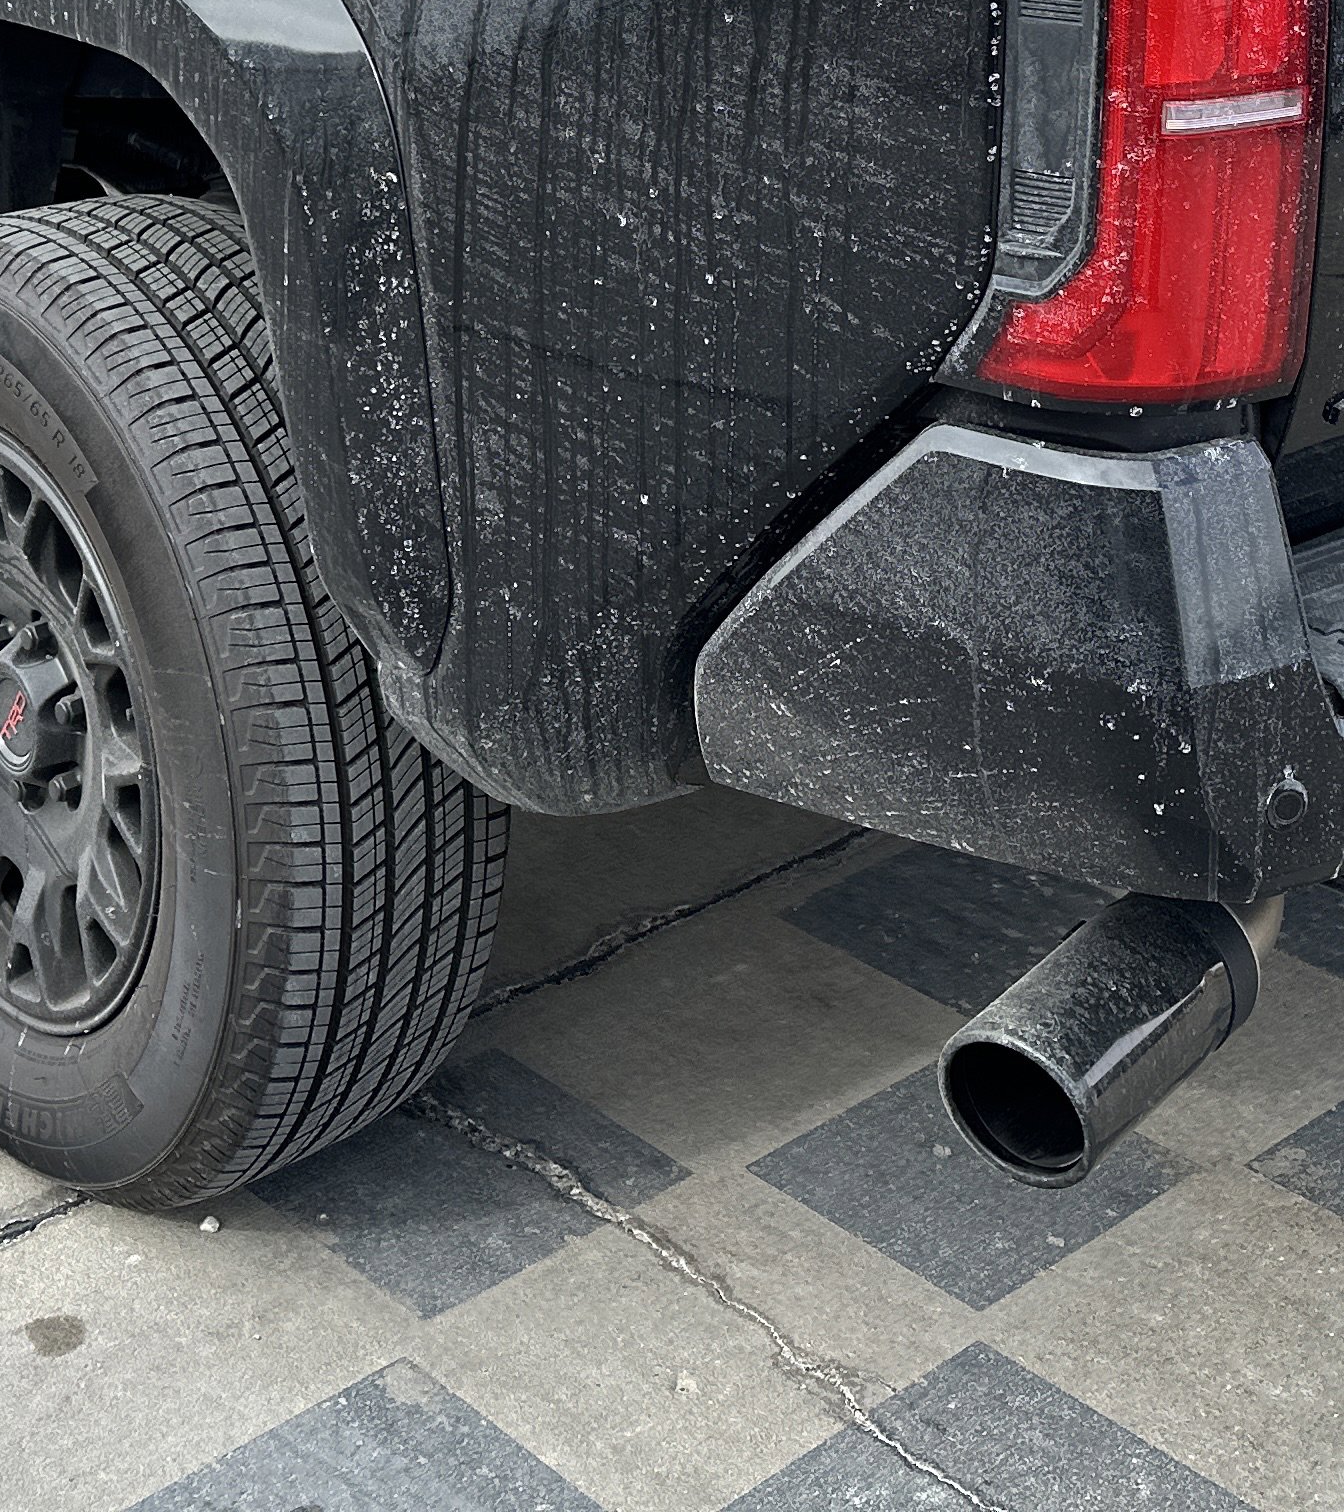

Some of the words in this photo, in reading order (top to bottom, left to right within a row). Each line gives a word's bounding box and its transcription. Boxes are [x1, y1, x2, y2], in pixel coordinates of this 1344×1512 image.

[51, 428, 67, 449] R
[67, 454, 86, 479] 18
[0, 690, 26, 740] TRD
